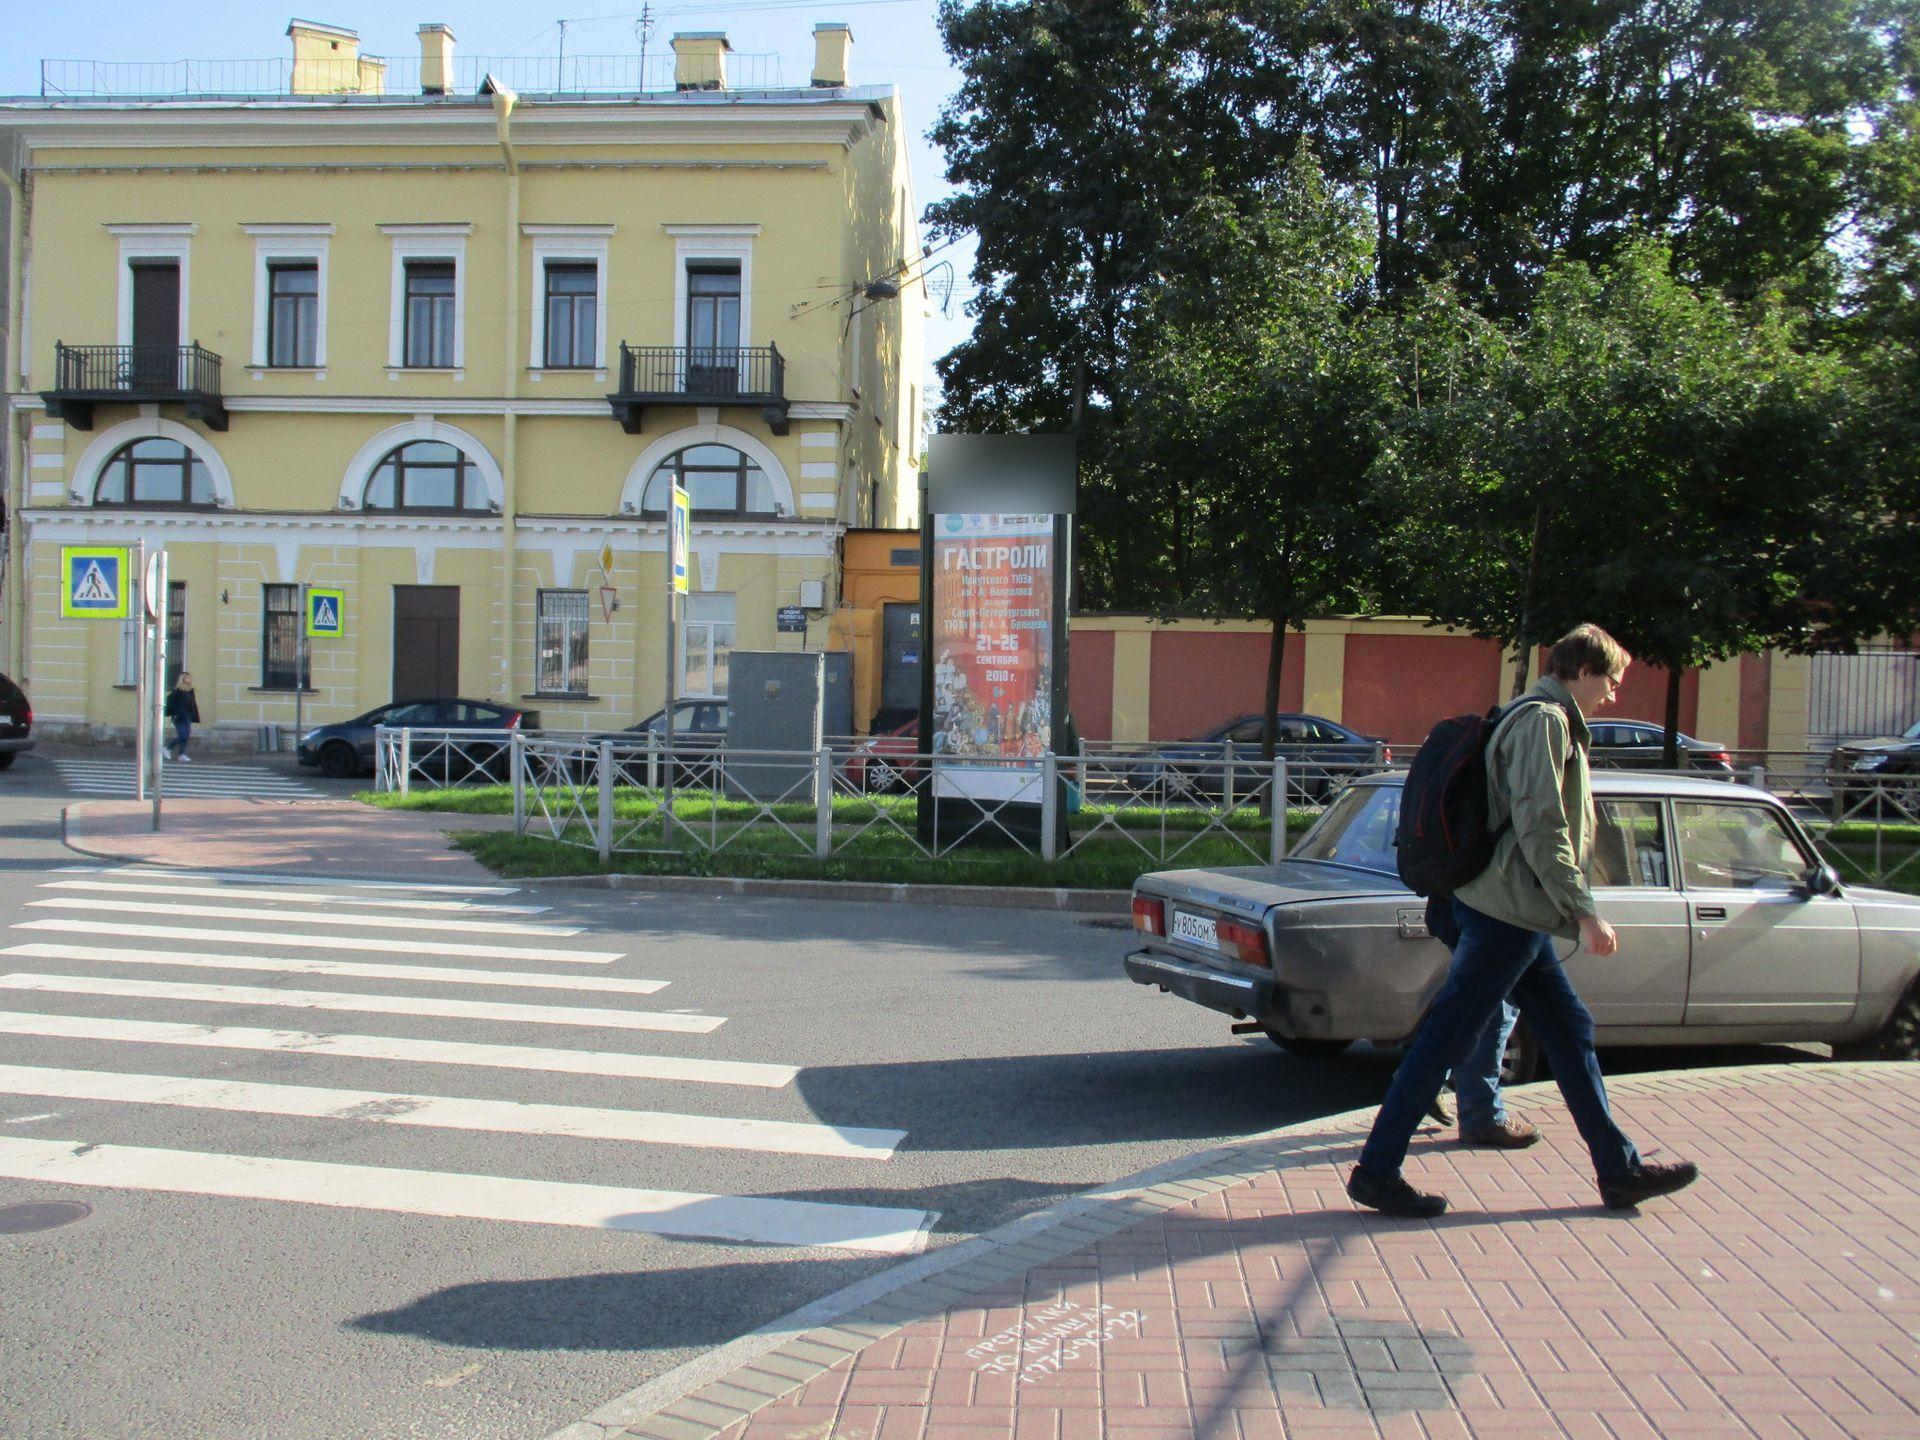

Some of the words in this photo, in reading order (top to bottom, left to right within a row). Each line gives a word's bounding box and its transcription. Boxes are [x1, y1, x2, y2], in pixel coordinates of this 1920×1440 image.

[943, 545, 1048, 570] ГАСТРОЛИ
[976, 634, 1018, 651] 21-26
[986, 671, 1008, 682] 2018
